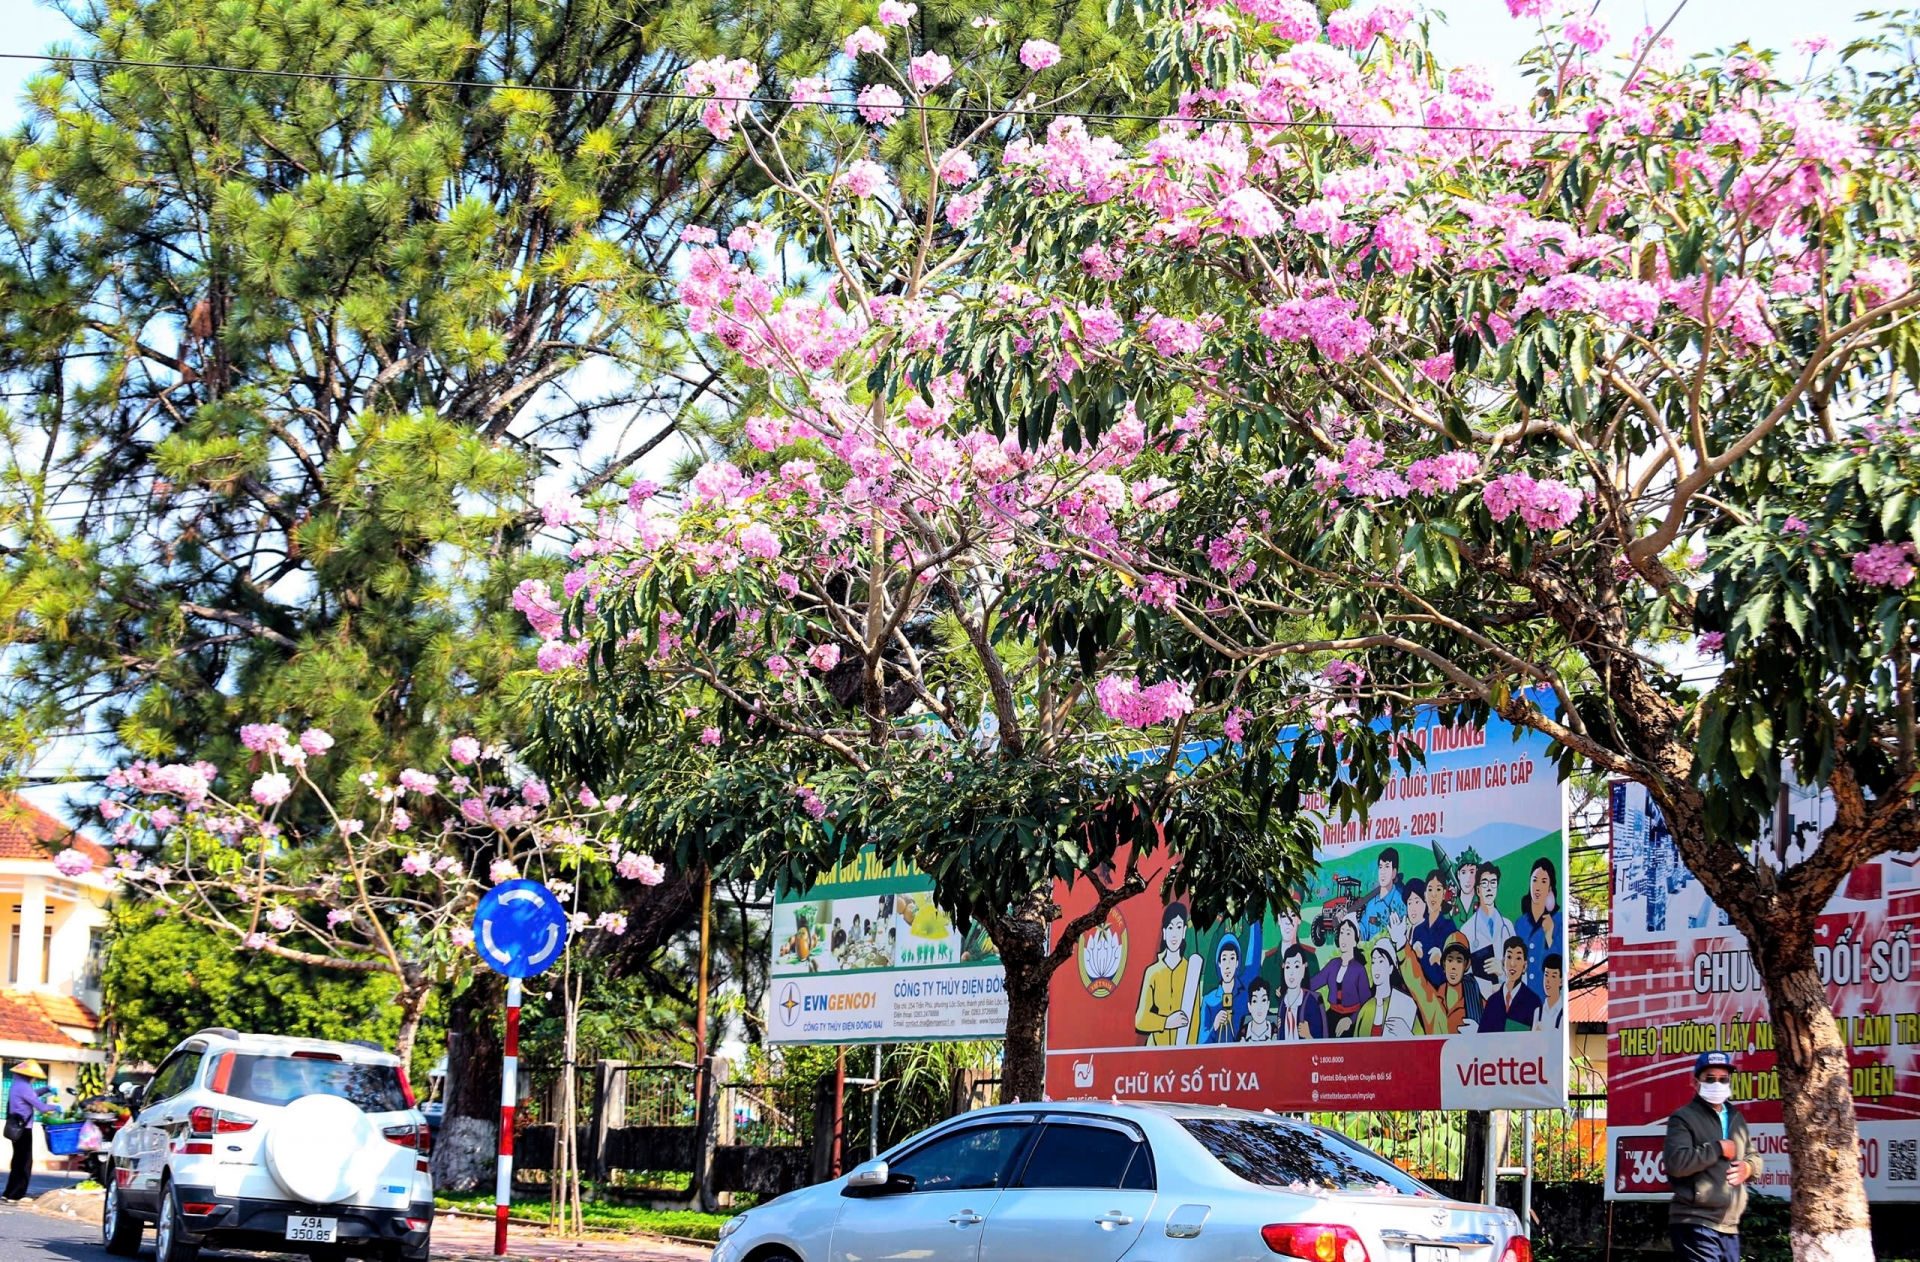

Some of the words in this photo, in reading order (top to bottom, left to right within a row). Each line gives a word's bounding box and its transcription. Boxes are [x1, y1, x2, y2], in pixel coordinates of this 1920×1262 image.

[1400, 768, 1427, 800] QUỐC
[1431, 768, 1453, 798] VIỆT
[1456, 768, 1481, 792] NAM
[1485, 760, 1507, 788] CÁC
[1511, 754, 1533, 786] CẤP
[1375, 817, 1400, 840] 2024
[1410, 813, 1437, 836] 2029
[1871, 924, 1912, 983] SỐ
[894, 979, 920, 998] CÔNG
[922, 981, 934, 996] TY
[936, 977, 960, 995] THỦY
[962, 977, 984, 998] ĐIỆN
[1619, 1027, 1657, 1056] THEO
[1661, 1019, 1716, 1054] HƯỚNG
[1720, 1012, 1751, 1052] LẤY
[1852, 1009, 1891, 1047] LÀM
[1895, 1013, 1920, 1045] TR
[1114, 1071, 1149, 1095] CHỮ
[1153, 1069, 1176, 1093] KÝ
[1180, 1065, 1204, 1093] SỐ
[1208, 1067, 1232, 1092] TỪ
[1236, 1071, 1260, 1092] XA
[1456, 1056, 1548, 1086] viettel
[1852, 1060, 1895, 1103] DIỆN
[291, 1229, 331, 1240] 350.85
[301, 1217, 322, 1228] 49A
